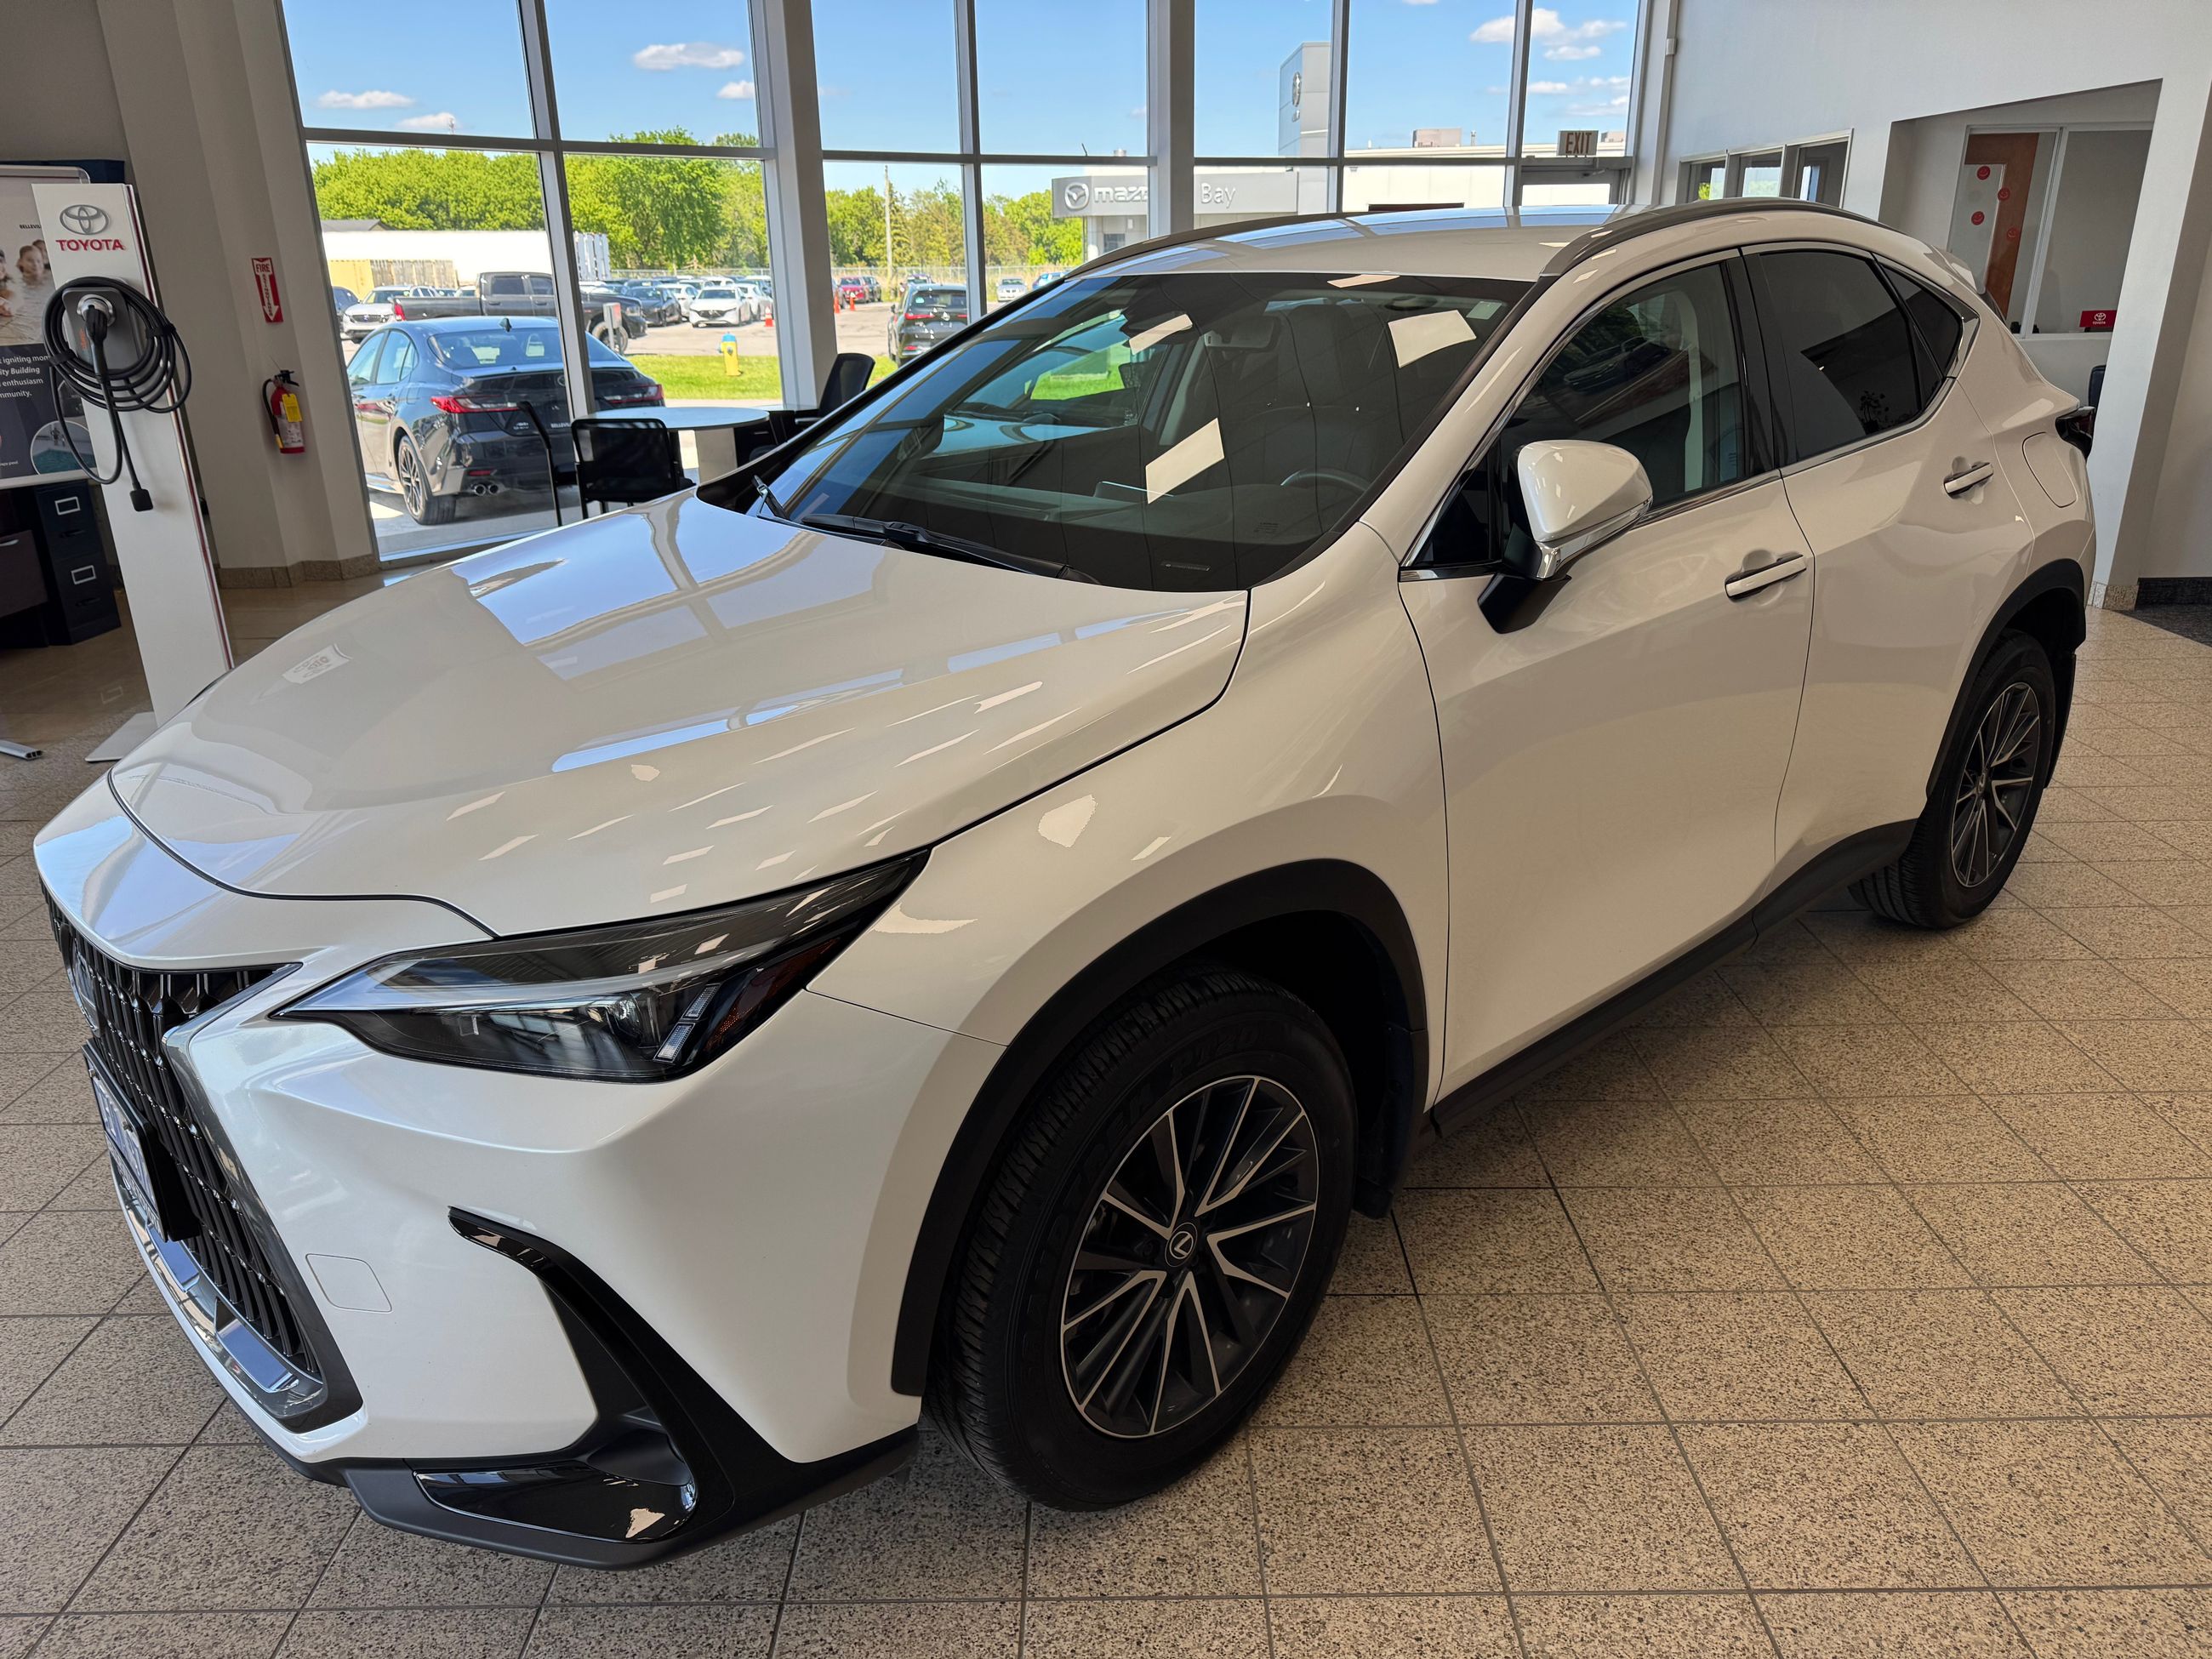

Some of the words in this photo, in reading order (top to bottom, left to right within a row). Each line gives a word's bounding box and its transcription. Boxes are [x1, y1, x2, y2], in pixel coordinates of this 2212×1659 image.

[1565, 132, 1593, 154] EXIT
[1200, 182, 1236, 208] Bay
[55, 238, 125, 251] TOYOTA
[256, 264, 271, 272] FIRE
[3, 356, 31, 365] igniting
